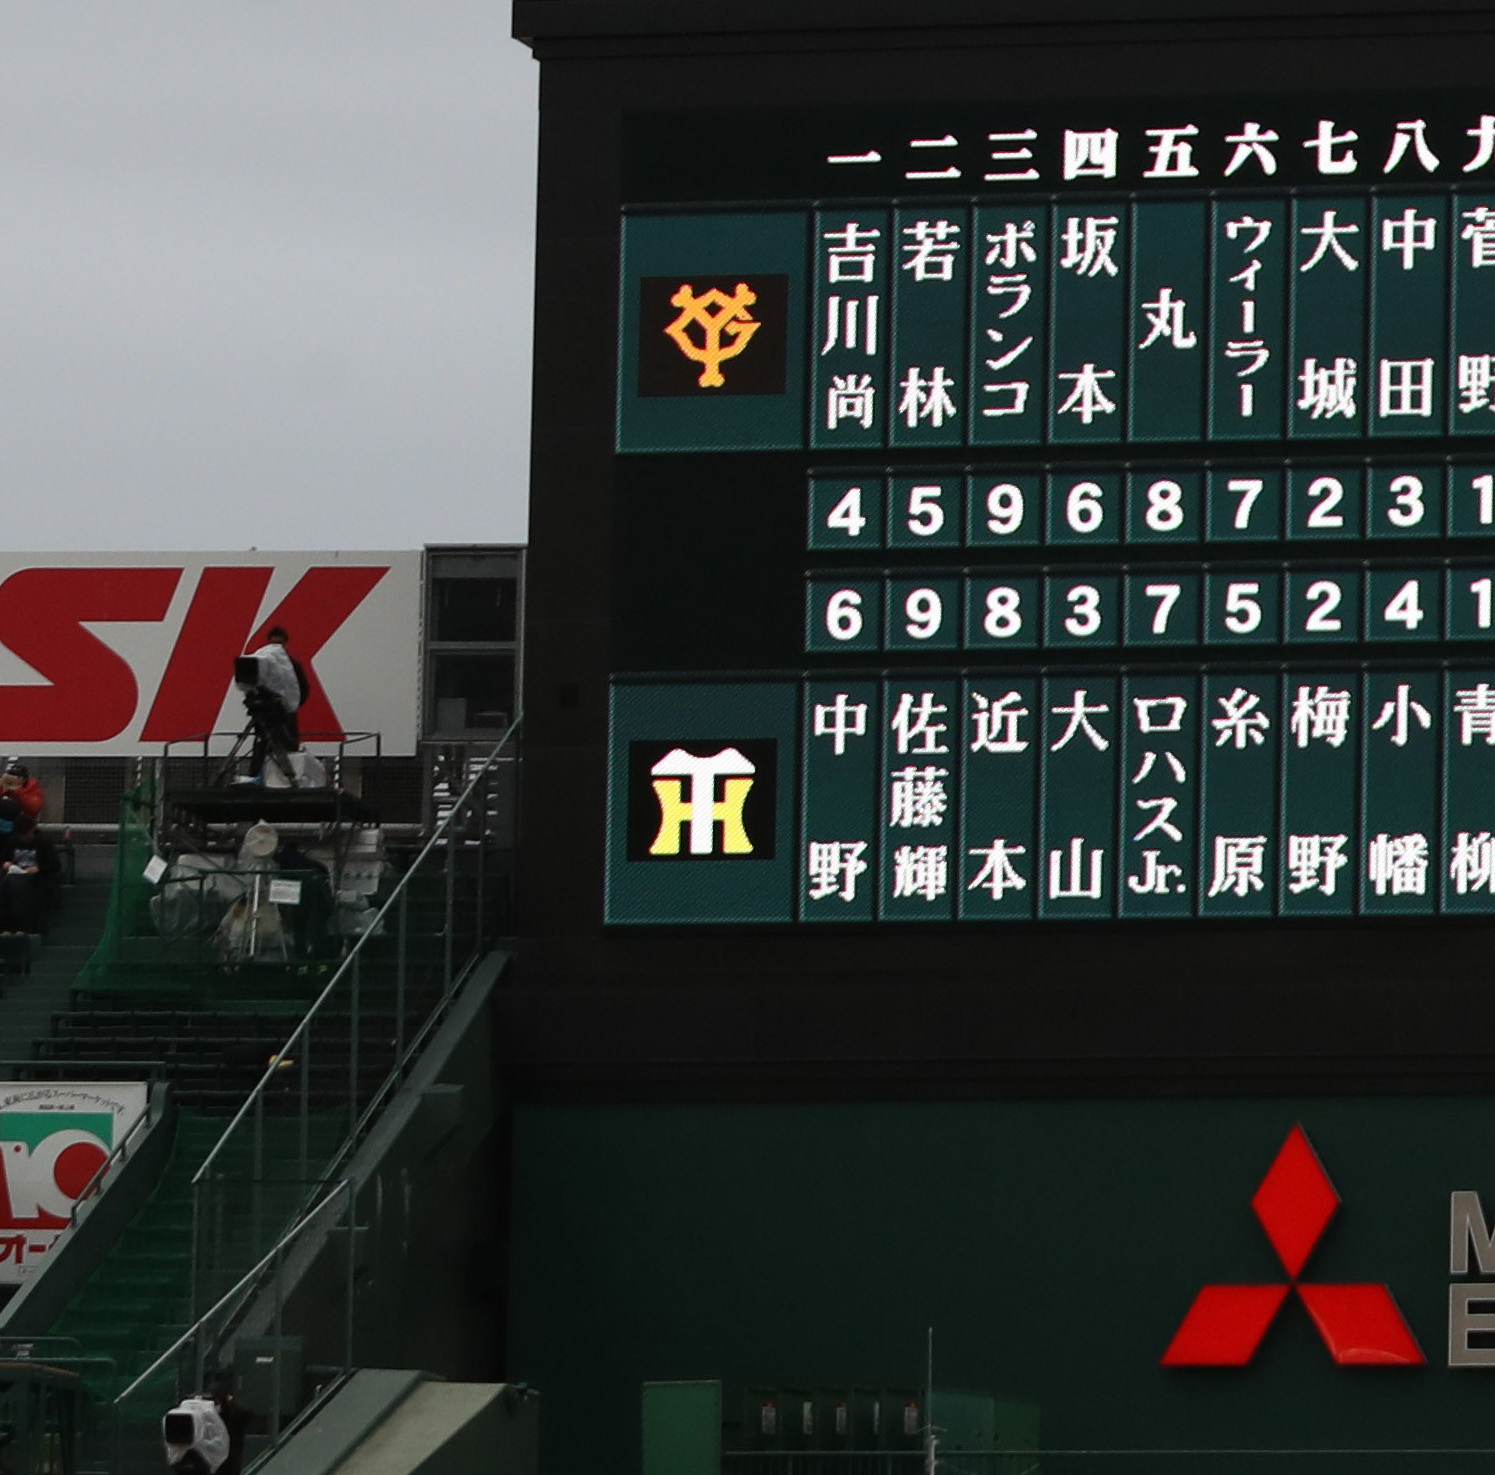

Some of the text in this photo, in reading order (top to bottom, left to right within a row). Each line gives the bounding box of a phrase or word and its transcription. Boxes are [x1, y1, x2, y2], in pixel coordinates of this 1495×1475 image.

[828, 151, 881, 162] 一
[906, 136, 961, 178] 二
[985, 130, 1039, 180] 三
[1064, 128, 1118, 180] 四
[1144, 125, 1198, 177] 五
[1225, 123, 1278, 176] 六
[1304, 121, 1358, 173] 七
[1384, 120, 1439, 173] 八
[822, 223, 880, 429] 吉川尚
[899, 221, 960, 427] 若林
[983, 221, 1036, 416] ポランコ
[1058, 217, 1118, 423] 坂本
[1139, 289, 1196, 348] 丸
[1225, 217, 1271, 416] ウィーラー
[1298, 211, 1358, 418] 大城
[1380, 209, 1436, 417] 中田
[828, 475, 1493, 536] 4 5 9 6 8 7 2 3 1
[827, 579, 1491, 640] 6 9 8 3 7 5 2 4 1
[809, 695, 867, 901] 中野
[890, 693, 949, 900] 佐藤輝
[968, 692, 1028, 900] 近本
[1050, 691, 1108, 899] 大山
[1208, 688, 1269, 897] 糸原
[1289, 687, 1350, 895] 梅野
[1369, 685, 1431, 895] 小幡
[0, 1234, 61, 1264] オー
